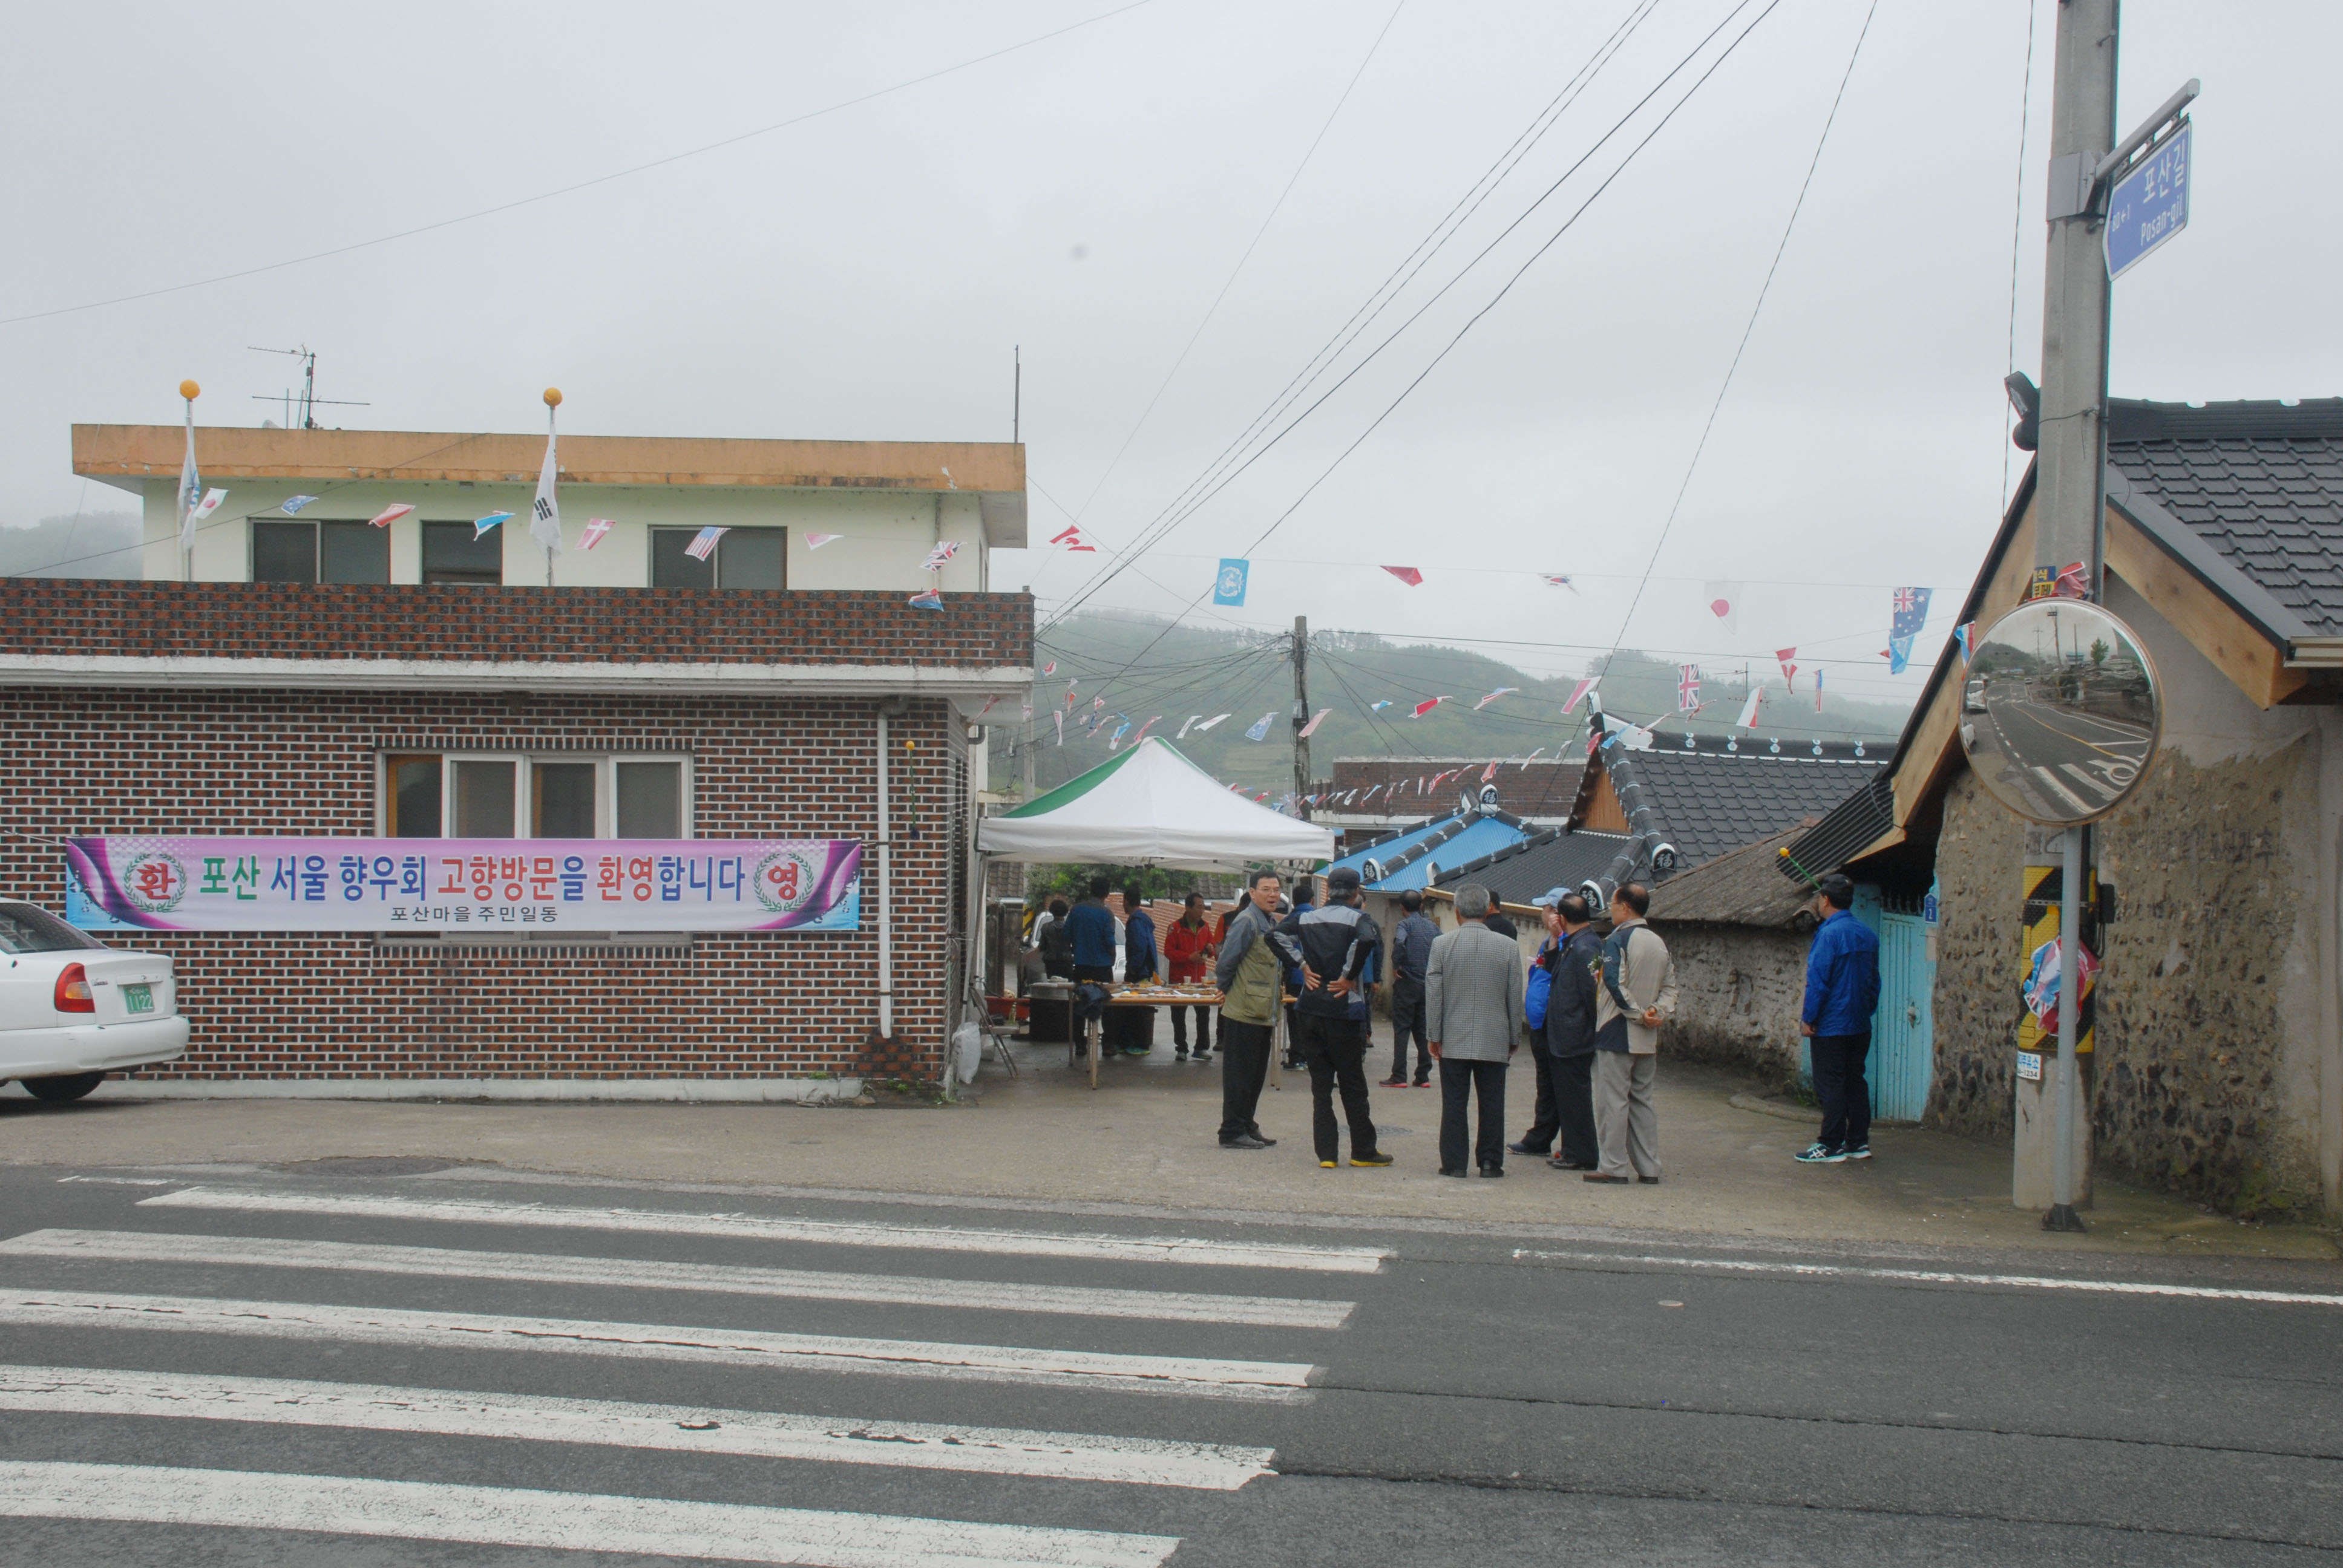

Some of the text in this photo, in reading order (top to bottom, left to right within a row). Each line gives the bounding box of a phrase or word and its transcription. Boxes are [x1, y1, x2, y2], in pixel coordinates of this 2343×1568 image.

[2143, 139, 2186, 204] 포산길
[2140, 193, 2183, 246] Posan-gil
[200, 855, 746, 902] 포산 서울 향우회 고향방문을 환영합니다
[1657, 853, 1673, 867] 福
[136, 862, 177, 900] 환
[767, 862, 798, 900] 영
[390, 906, 557, 923] 포산마을 주민일동
[1928, 908, 1933, 920] 2
[129, 995, 154, 1010] 1122
